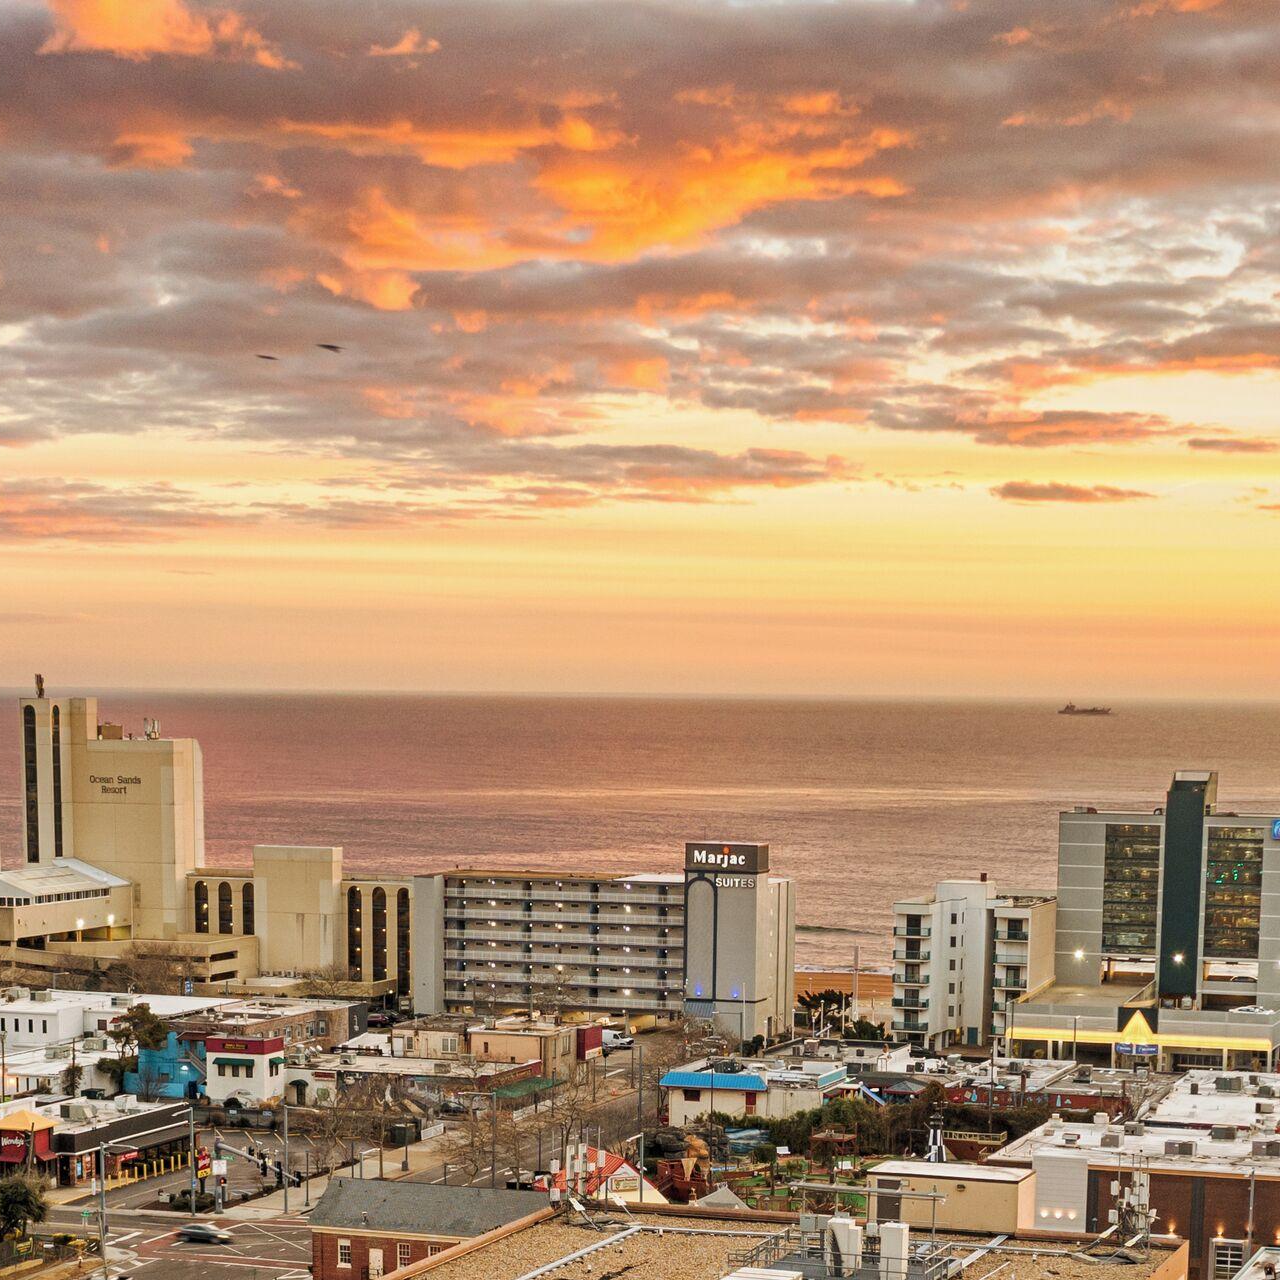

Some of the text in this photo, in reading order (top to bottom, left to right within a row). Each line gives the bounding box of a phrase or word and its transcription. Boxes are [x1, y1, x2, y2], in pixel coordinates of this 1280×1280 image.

[89, 775, 142, 785] Ocean Sands
[101, 785, 127, 795] Resort
[693, 847, 746, 868] Marjac
[715, 877, 754, 888] SUITES
